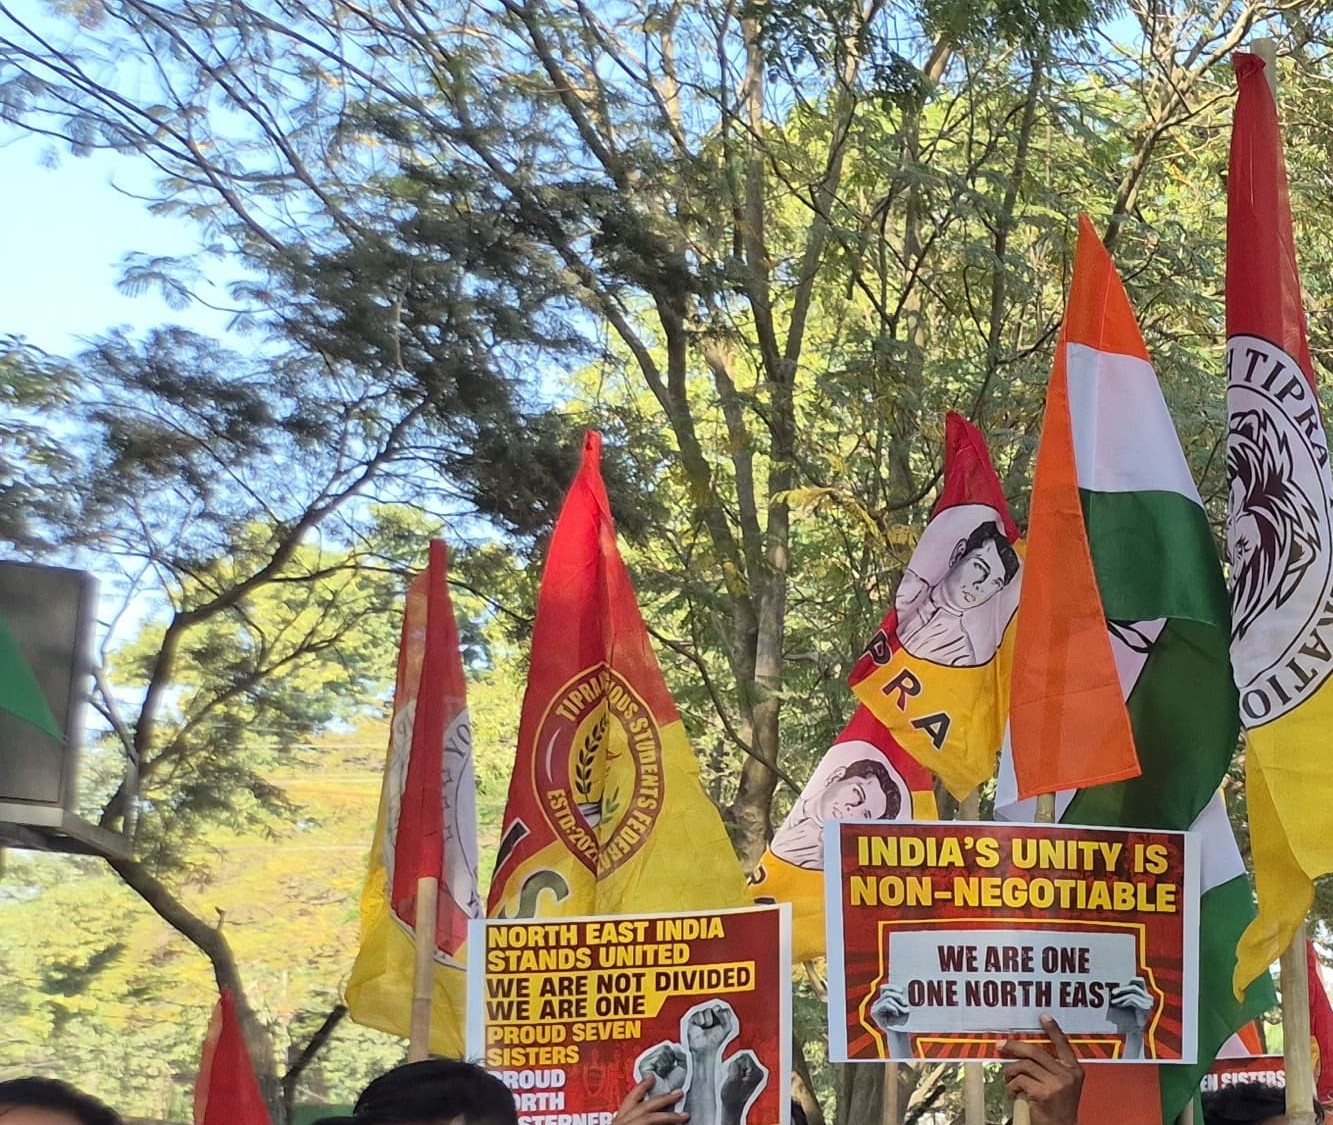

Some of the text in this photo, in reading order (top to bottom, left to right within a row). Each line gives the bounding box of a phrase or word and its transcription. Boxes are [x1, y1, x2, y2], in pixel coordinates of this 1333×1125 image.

[1246, 348, 1327, 468] TIPRA
[630, 717, 659, 810] STUDENTS
[857, 836, 1168, 875] INDIA'S UNITY IS
[850, 876, 1176, 913] NON-NEGOTIABLE
[488, 918, 725, 948] NORTH EAST INDIA
[488, 943, 690, 972] STANDS UNITED
[938, 945, 1090, 974] WE ARE ONE
[487, 966, 750, 998] WE ARE NOT DIVIDED
[907, 979, 1121, 1008] ONE NORTH EAST
[487, 995, 645, 1021] WE ARE ONE
[487, 1020, 641, 1045] PROUD SEVEN
[487, 1045, 580, 1067] SISTERS
